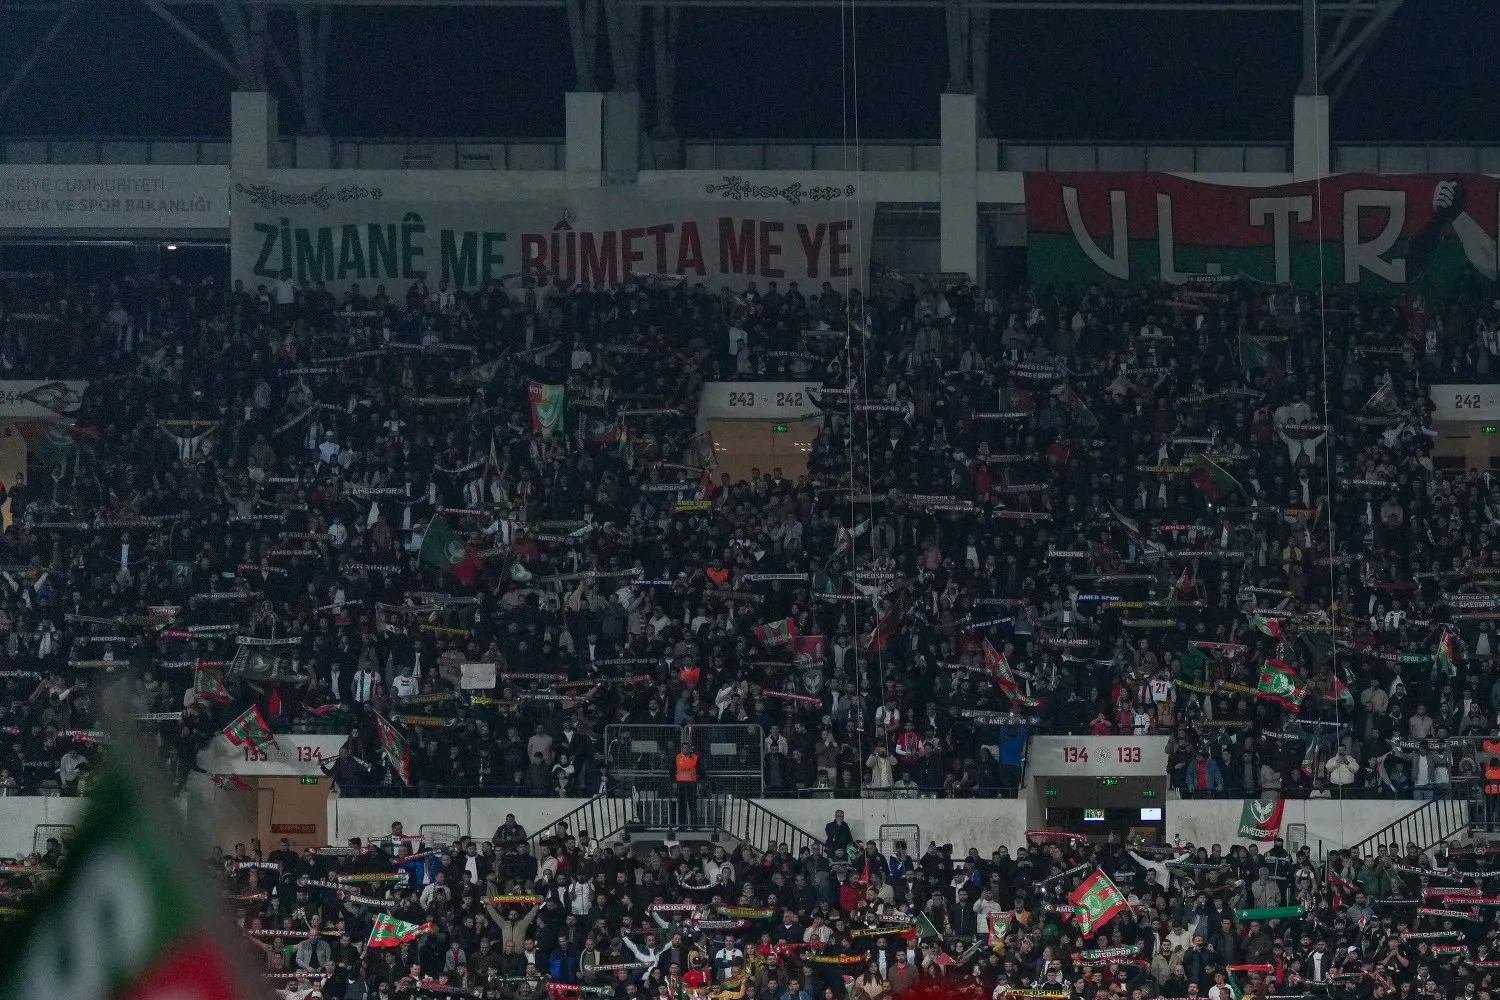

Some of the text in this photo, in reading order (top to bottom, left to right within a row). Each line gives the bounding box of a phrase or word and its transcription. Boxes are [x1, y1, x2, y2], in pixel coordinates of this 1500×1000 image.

[56, 199, 77, 212] VE
[80, 199, 120, 212] SPOR
[252, 211, 428, 282] ZİMANÊ
[441, 230, 506, 287] ME
[718, 216, 783, 279] ME
[795, 219, 854, 278] YE
[729, 393, 803, 406] 243 242
[1455, 394, 1481, 408] 242
[1155, 683, 1166, 693] 21
[298, 747, 322, 762] 134
[1064, 747, 1141, 763] 134 133
[1240, 825, 1279, 838] AMEDSPOR
[1090, 950, 1130, 959] AMEDSPOR
